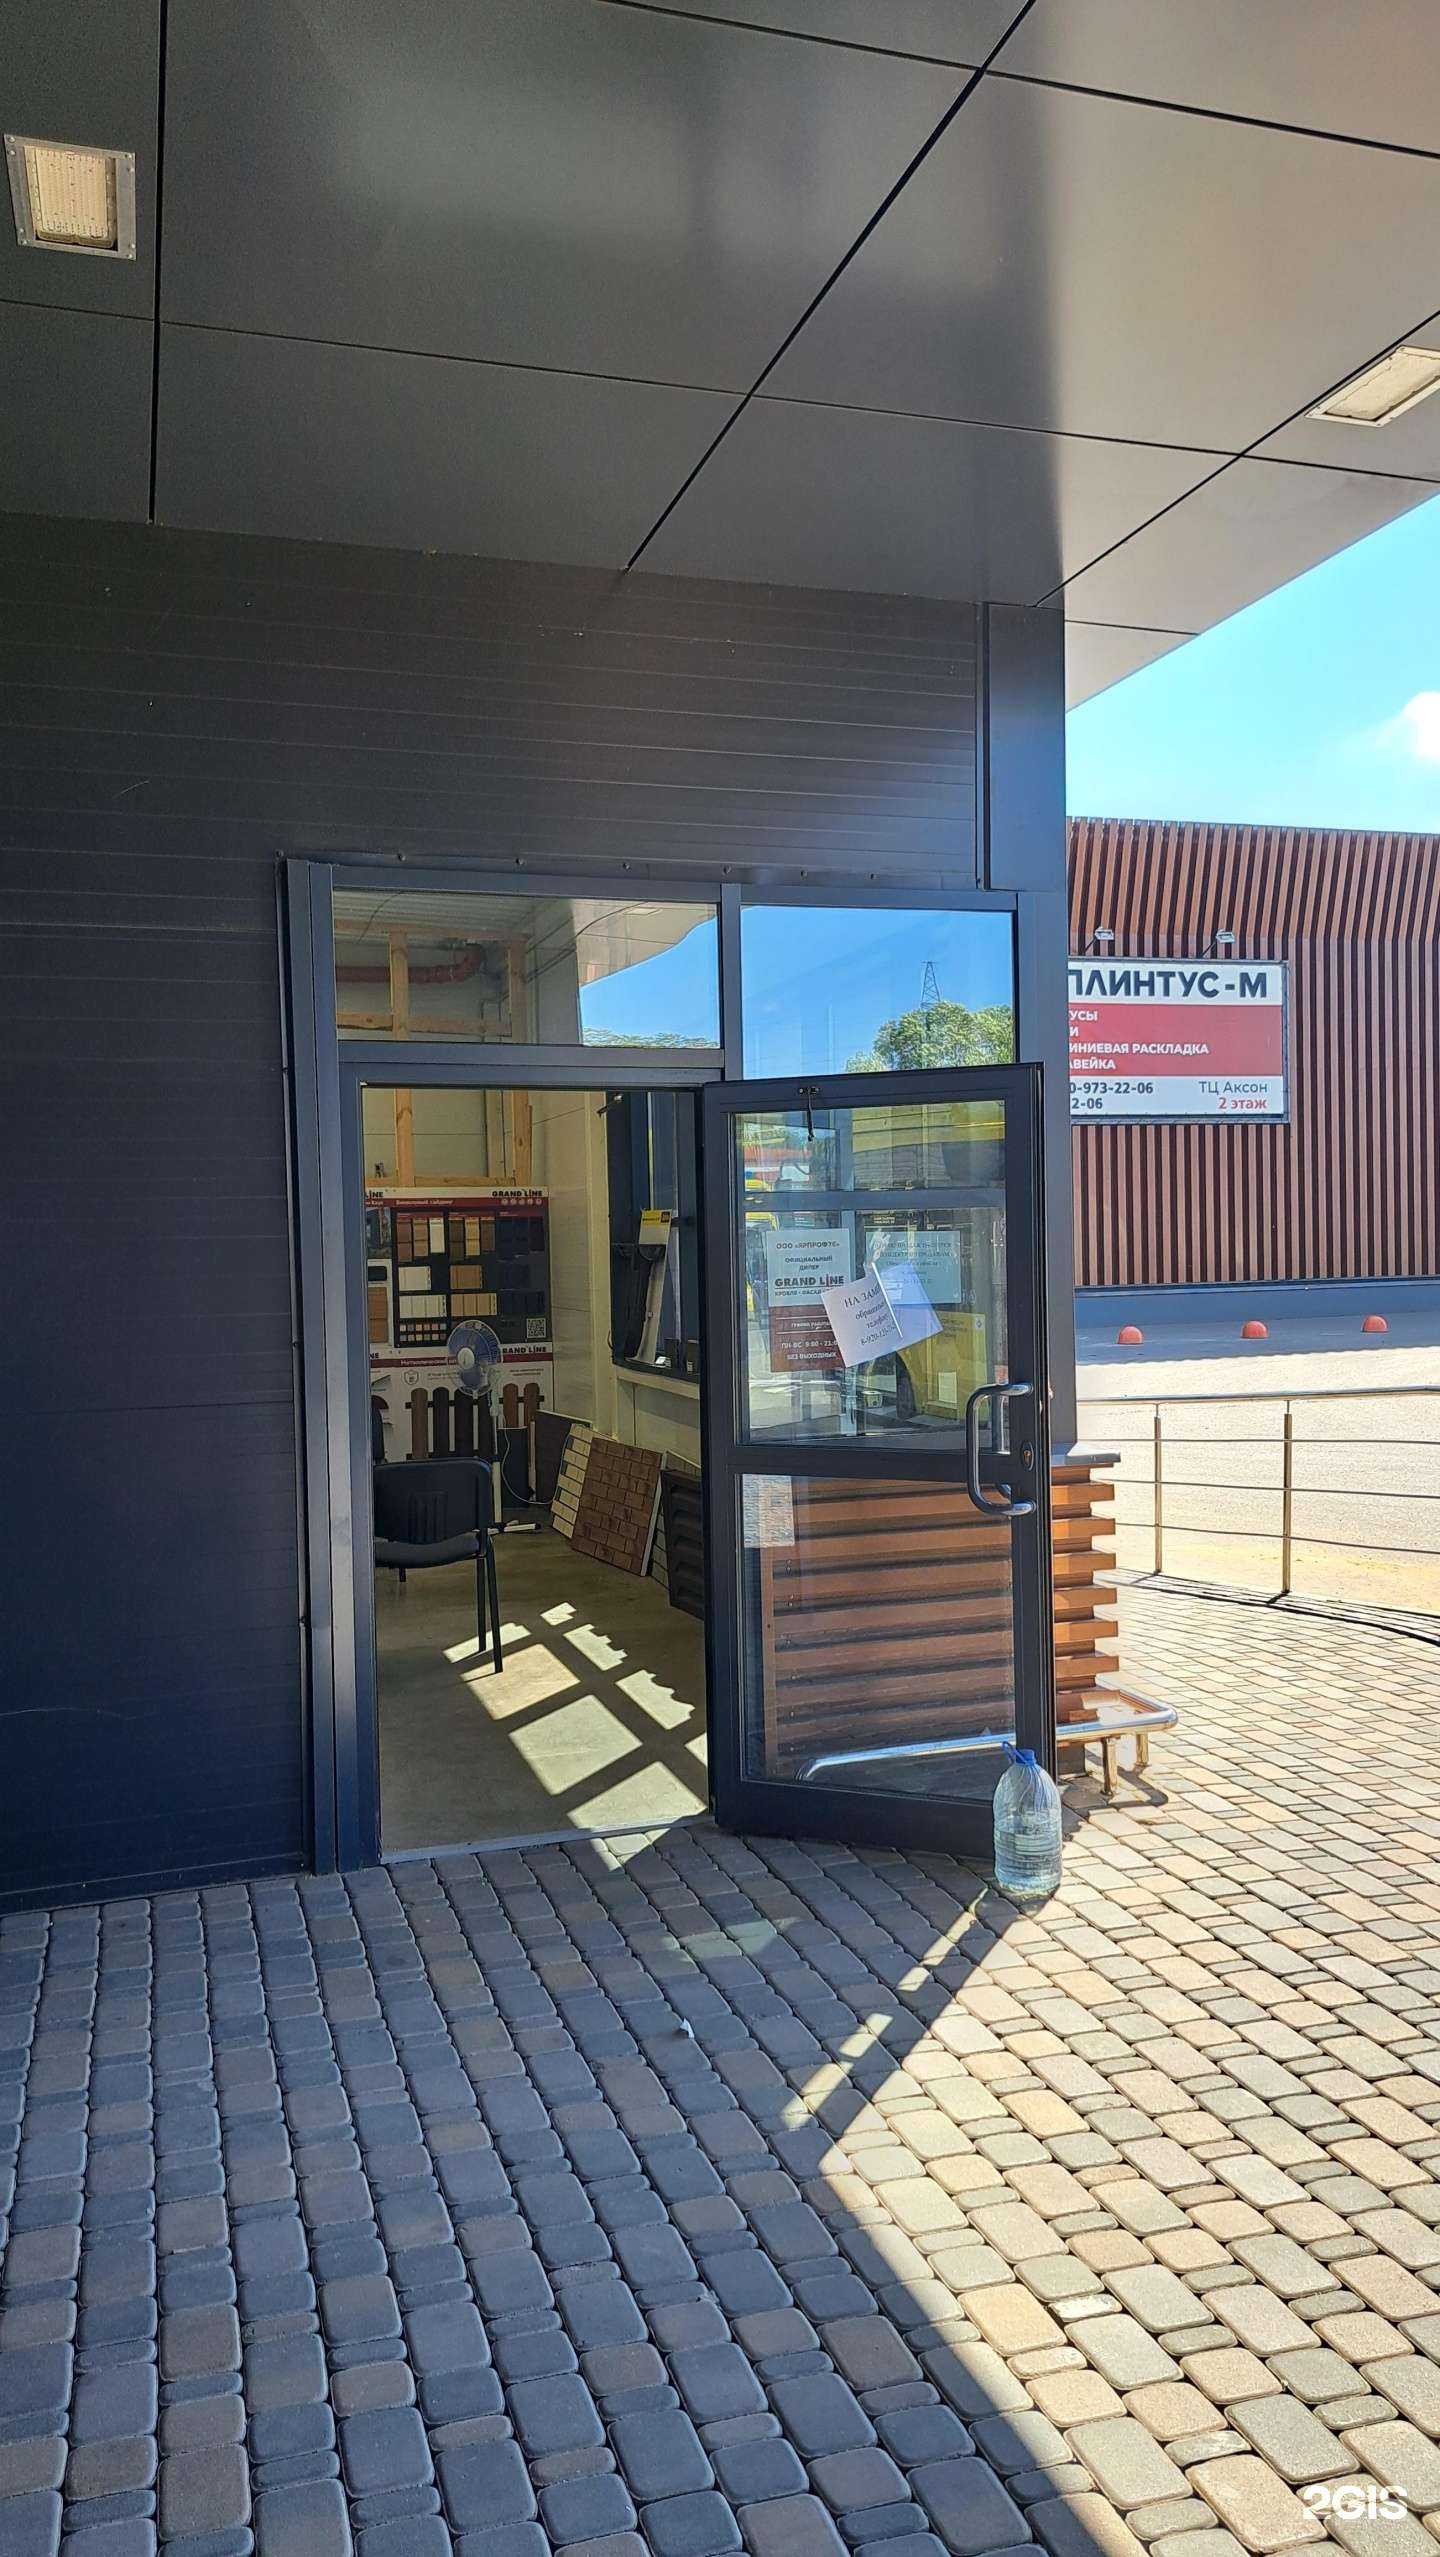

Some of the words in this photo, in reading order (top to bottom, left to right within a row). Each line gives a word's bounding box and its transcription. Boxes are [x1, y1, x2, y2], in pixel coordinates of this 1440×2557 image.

[1068, 969, 1267, 998] ПЛИНТУС-М
[1069, 1010, 1098, 1021] УСЫ
[1132, 1043, 1209, 1055] РАСКЛАДКА
[1198, 1080, 1219, 1096] ТЦ
[1223, 1080, 1268, 1093] Аксон
[1218, 1097, 1227, 1109] 2
[1230, 1099, 1267, 1109] этаж
[774, 1277, 817, 1287] GRAND
[819, 1273, 844, 1287] LINE
